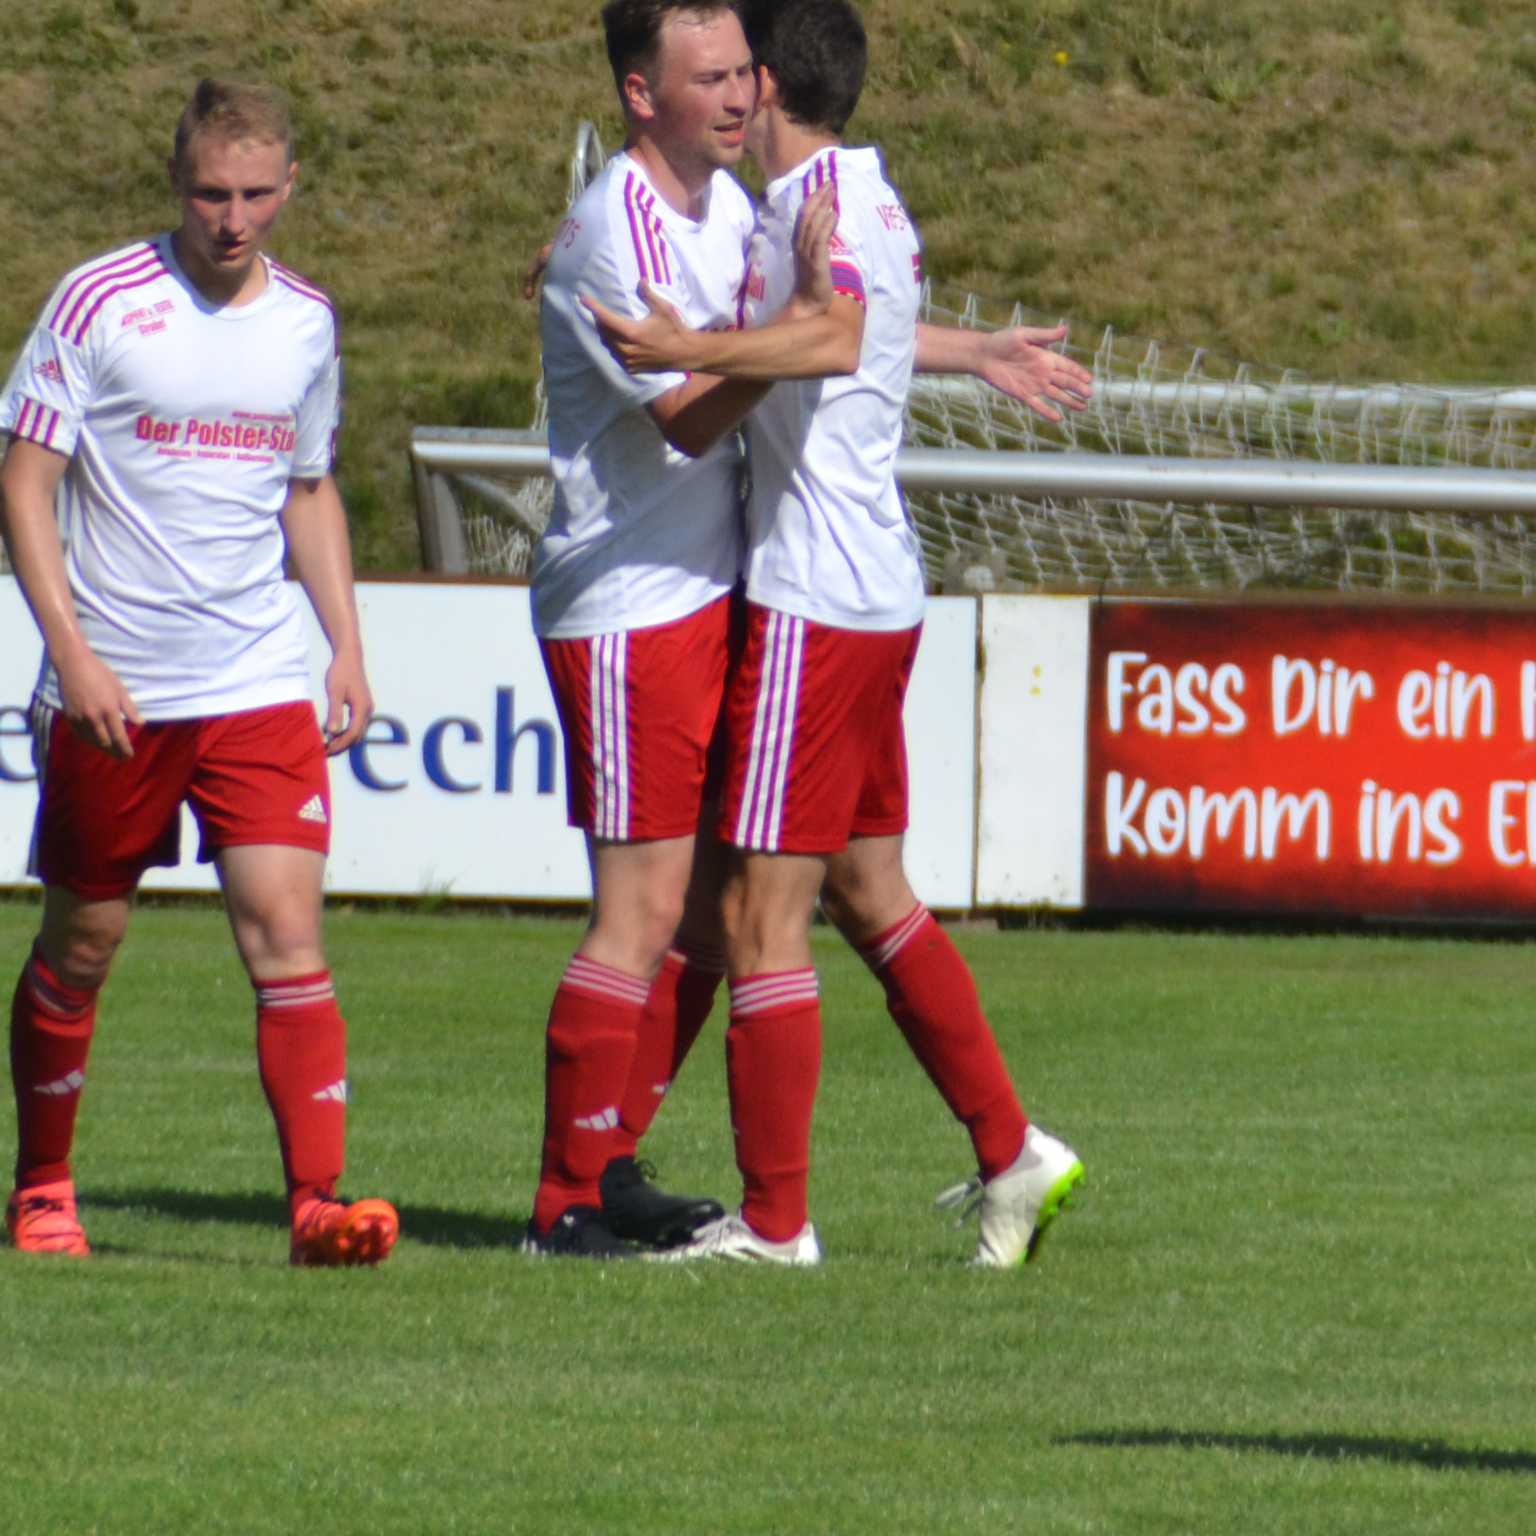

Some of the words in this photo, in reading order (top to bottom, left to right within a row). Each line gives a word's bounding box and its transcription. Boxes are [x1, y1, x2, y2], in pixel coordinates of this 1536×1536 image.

[135, 415, 181, 443] Der
[1106, 651, 1246, 736] Fass
[1271, 654, 1374, 737] Dir
[1397, 661, 1495, 739] ein
[1105, 770, 1331, 860] Komm
[1358, 779, 1462, 864] ins
